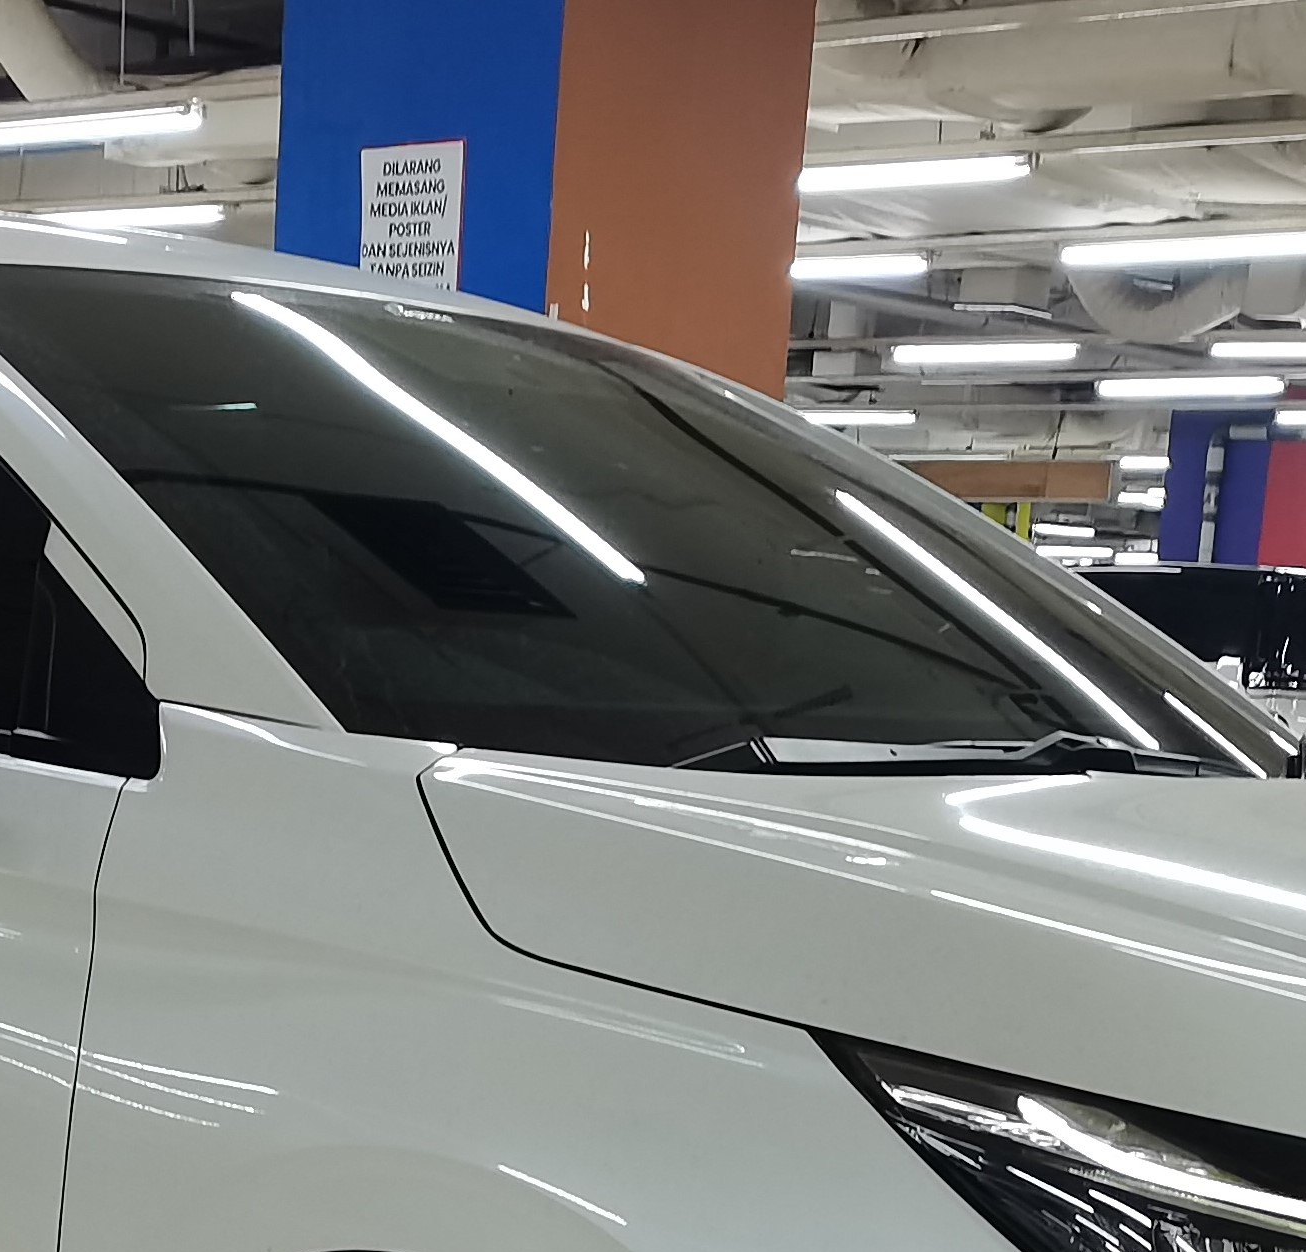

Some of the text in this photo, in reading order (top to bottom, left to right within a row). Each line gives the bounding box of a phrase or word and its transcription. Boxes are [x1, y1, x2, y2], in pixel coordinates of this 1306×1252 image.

[383, 158, 441, 176] DILARANG
[376, 178, 445, 198] MEMASANG
[369, 201, 409, 218] MEDIA
[389, 221, 431, 238] POSTER
[362, 239, 455, 258] DAN SEJENISNYA
[370, 260, 445, 279] TANPA SEIZIN
